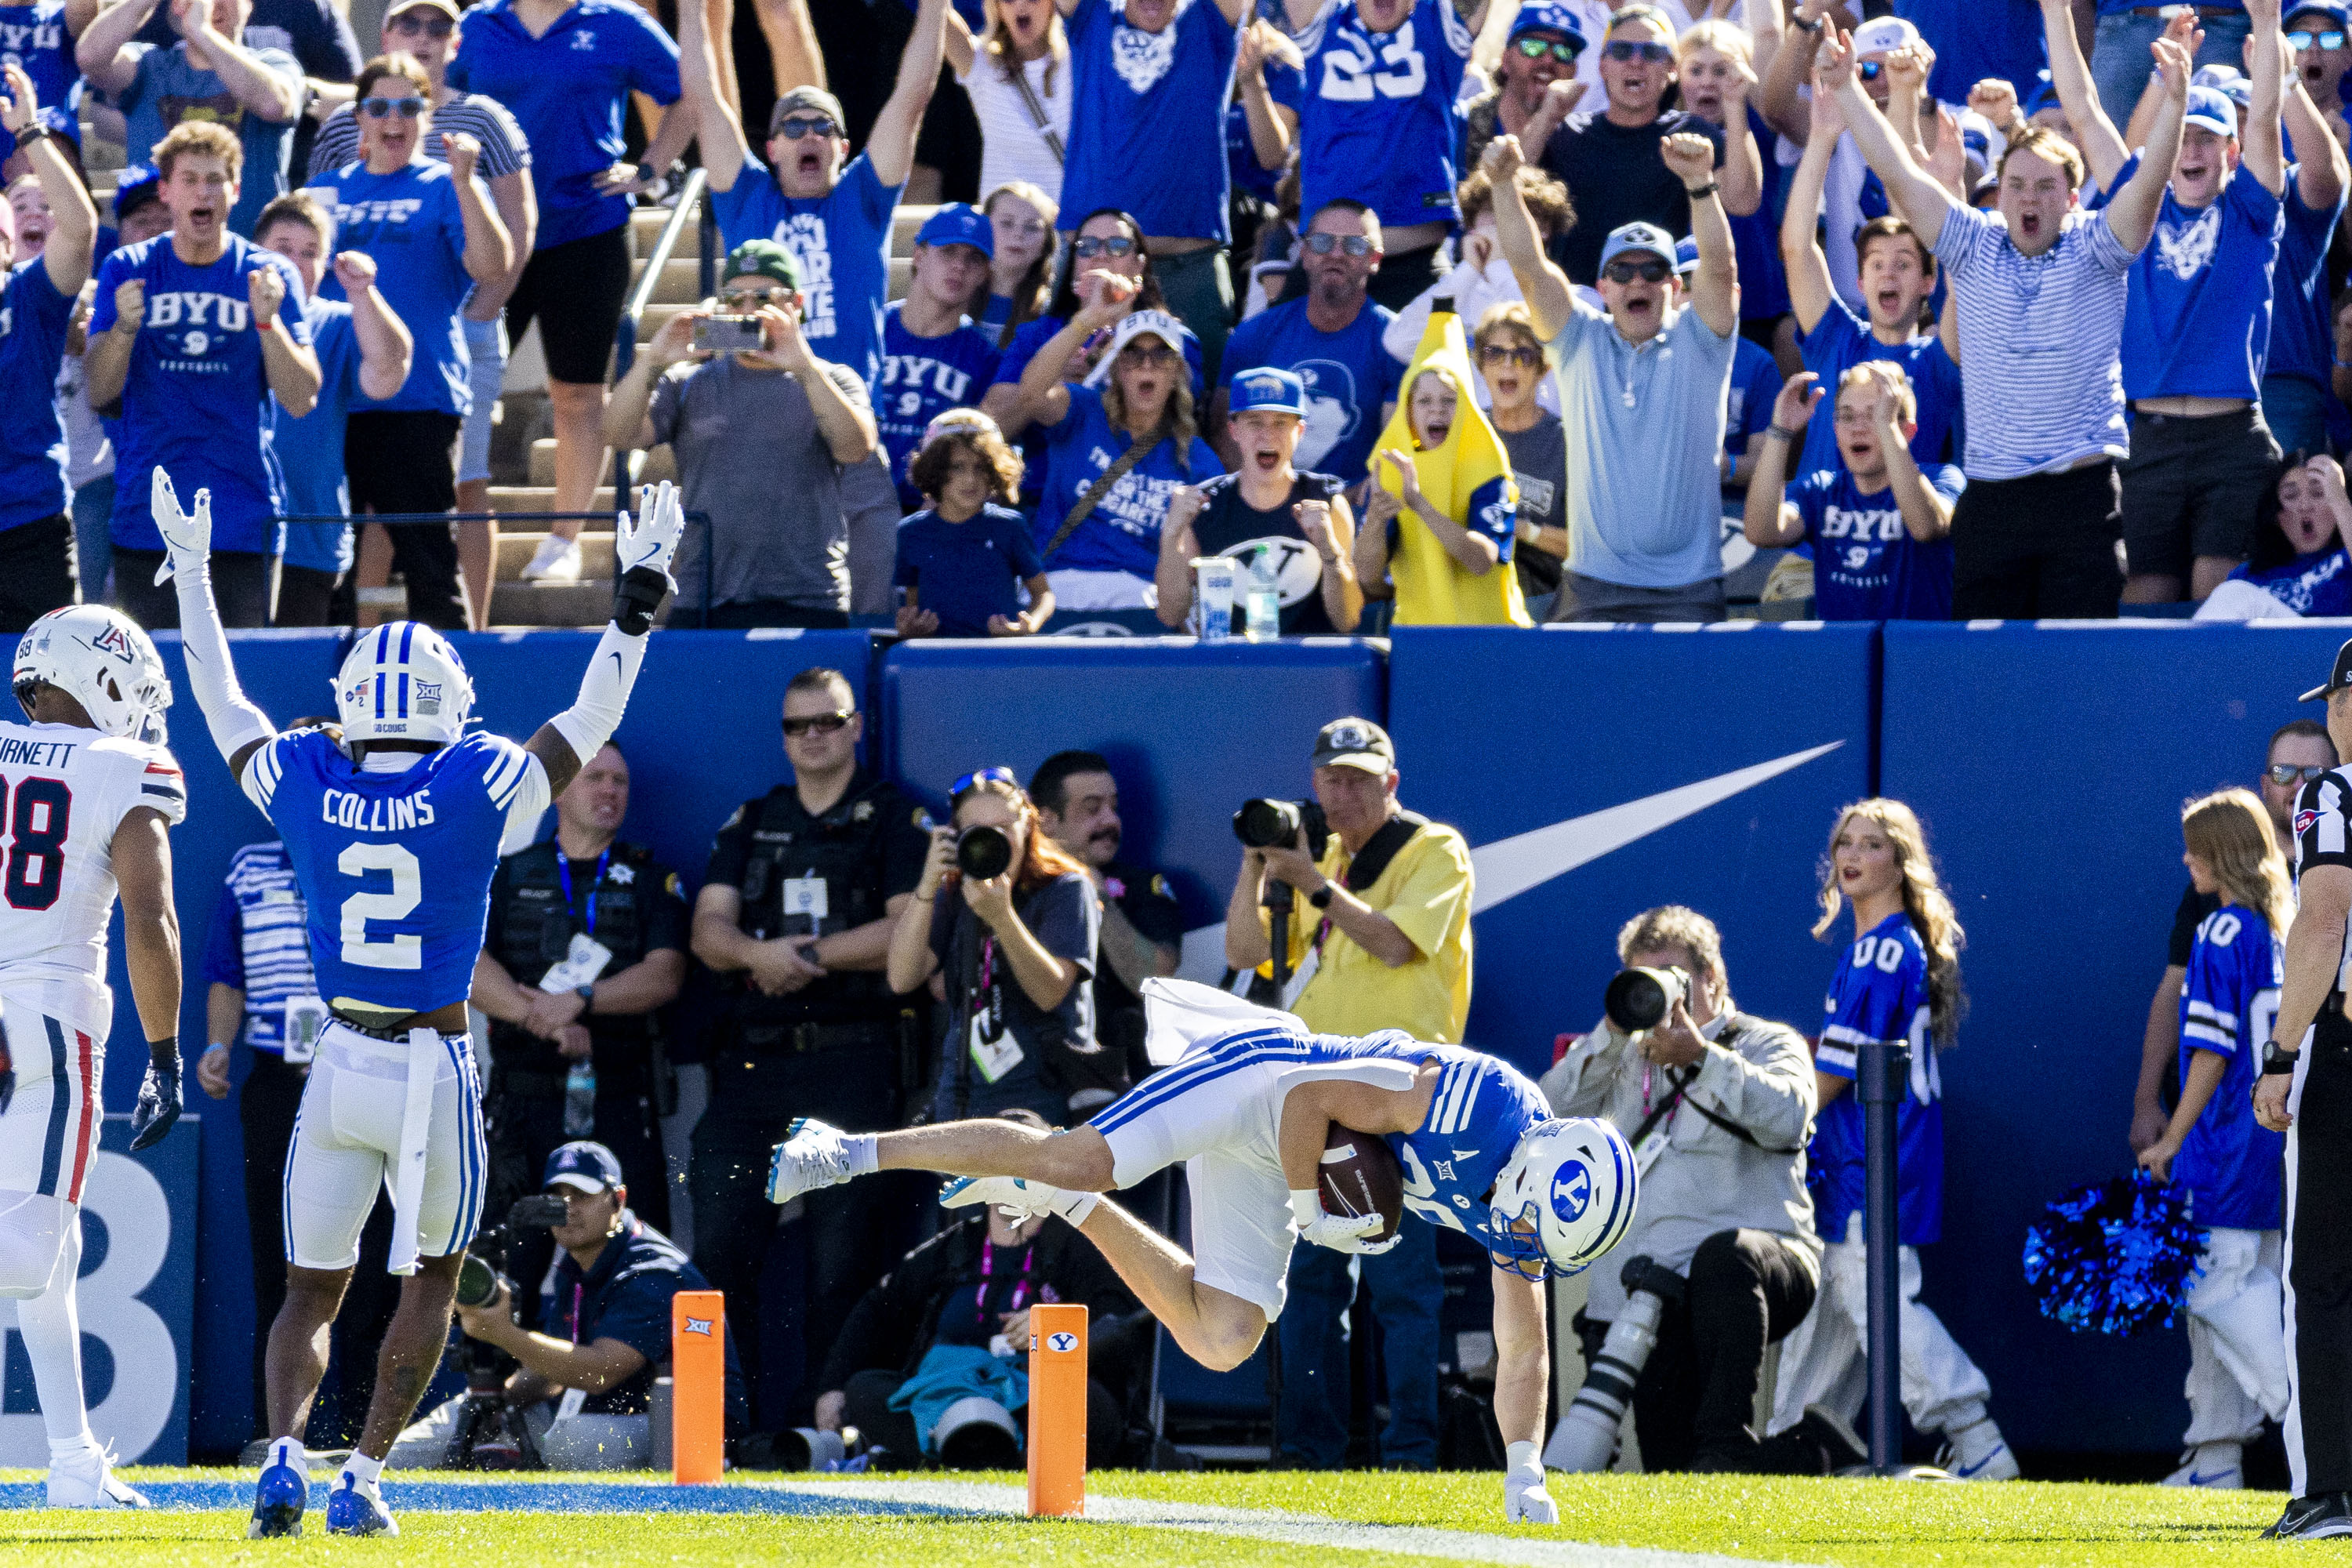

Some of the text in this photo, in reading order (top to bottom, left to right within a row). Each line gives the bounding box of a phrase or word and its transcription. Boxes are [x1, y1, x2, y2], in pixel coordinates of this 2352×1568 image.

[0, 22, 61, 49] YU
[1319, 20, 1427, 102] 23
[147, 292, 249, 332] BYU
[1127, 311, 1167, 329] BYU
[1820, 505, 1904, 541] BYU
[19, 639, 32, 659] 88
[358, 696, 365, 707] 2
[383, 723, 407, 733] COUGS
[323, 788, 435, 832] COLLINS
[0, 774, 72, 911] 8
[338, 841, 422, 970] 2
[1853, 935, 1904, 975] 00
[1553, 1169, 1588, 1215] Y
[1051, 1334, 1074, 1351] Y
